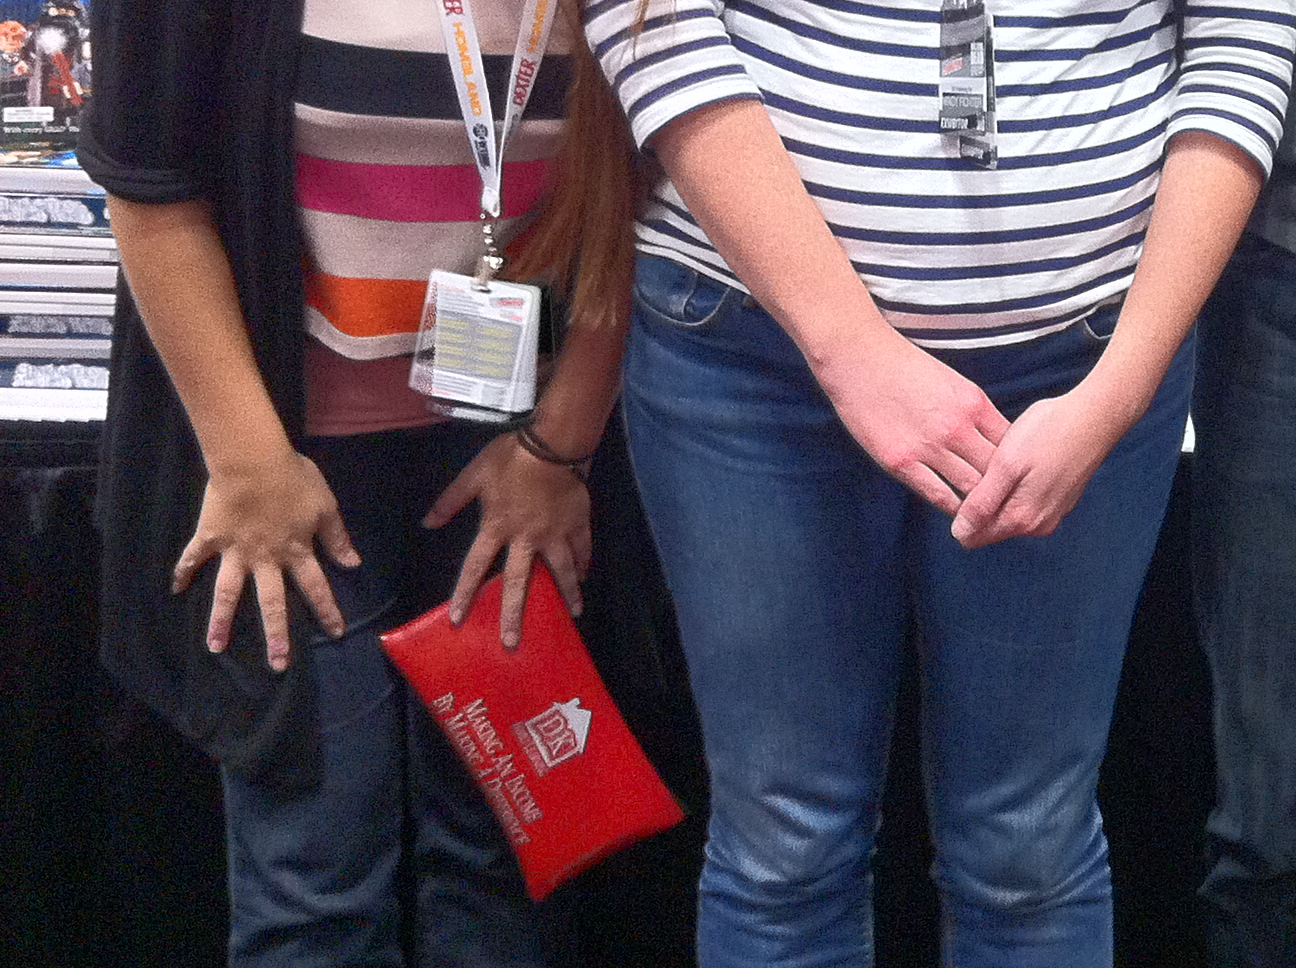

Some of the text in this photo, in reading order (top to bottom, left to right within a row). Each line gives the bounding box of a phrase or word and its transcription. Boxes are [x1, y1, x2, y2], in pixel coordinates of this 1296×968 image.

[513, 59, 537, 107] DEXTER
[462, 698, 505, 757] MAKING
[537, 714, 578, 757] DK
